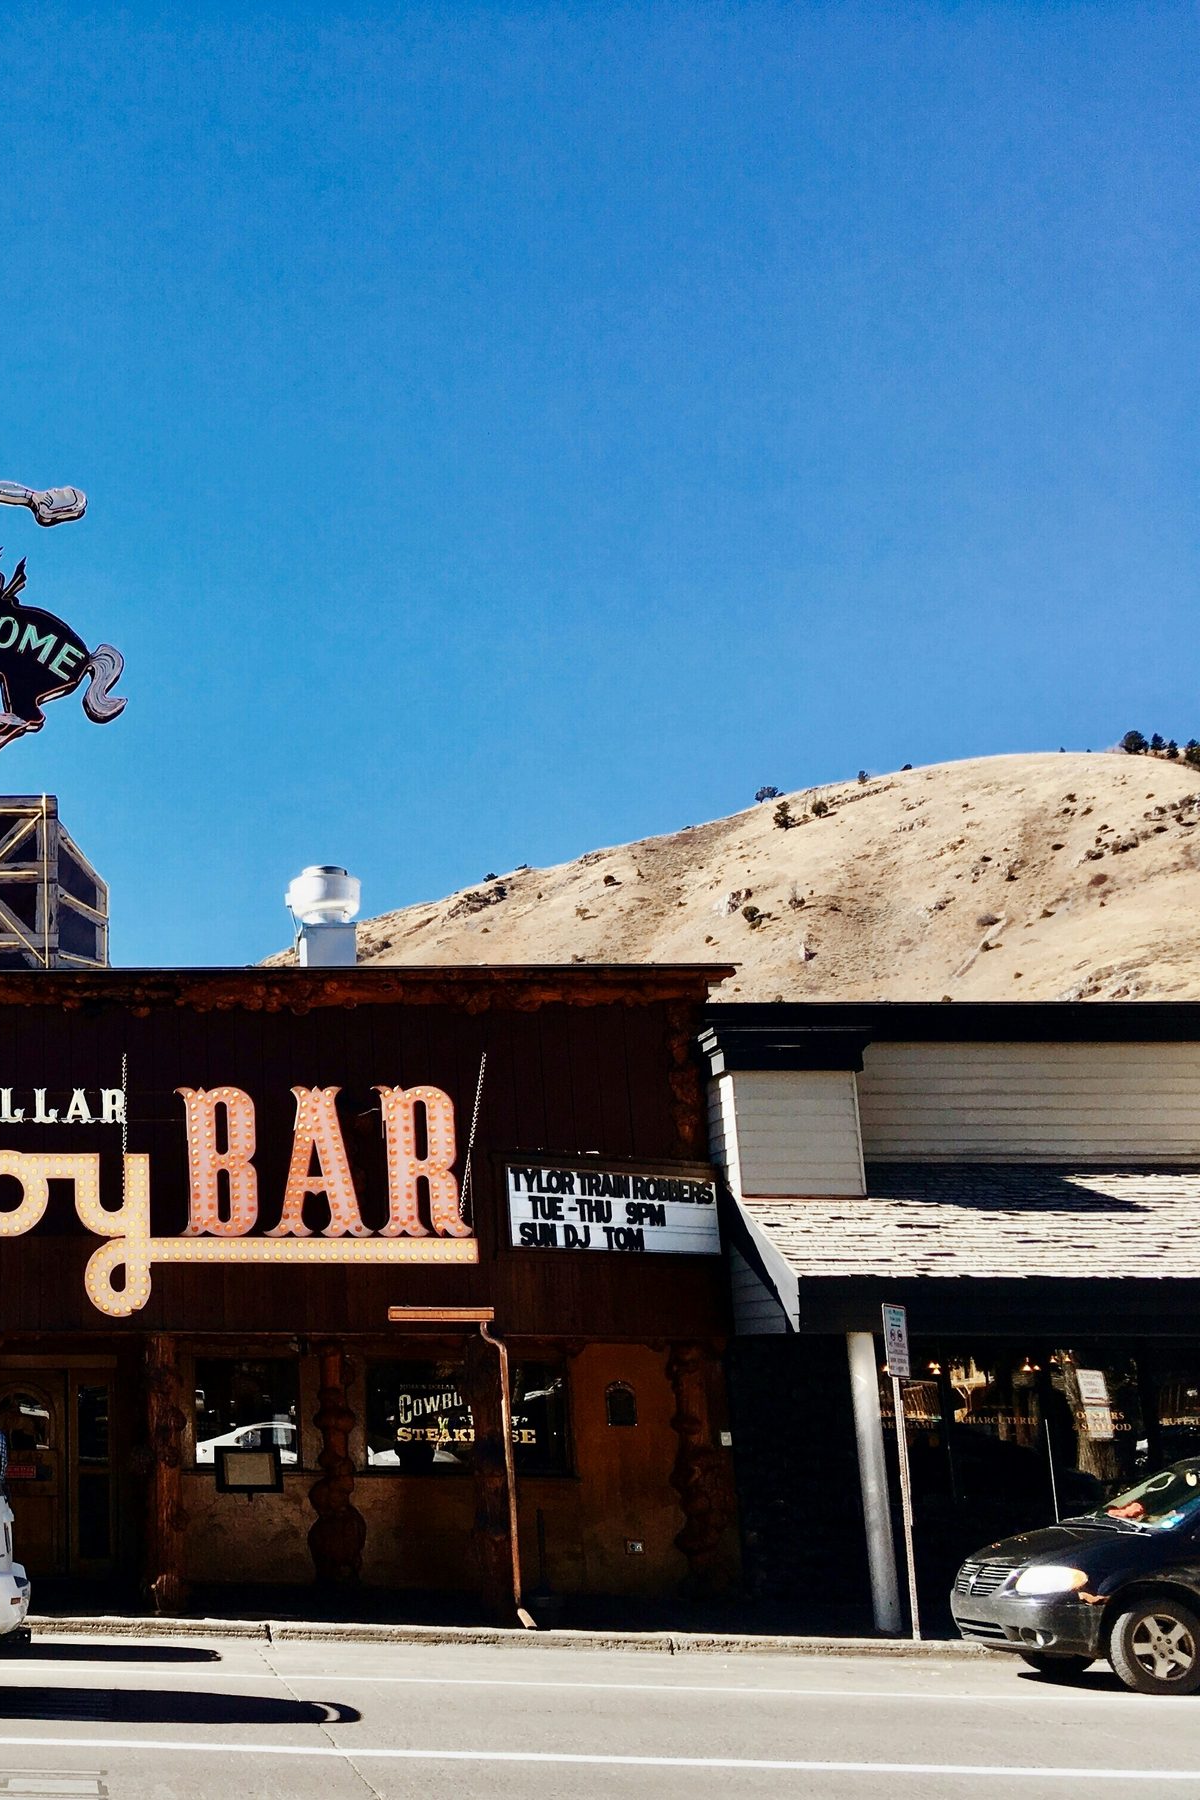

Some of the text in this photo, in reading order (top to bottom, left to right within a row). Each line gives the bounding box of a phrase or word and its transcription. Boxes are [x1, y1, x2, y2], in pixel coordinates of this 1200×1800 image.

[172, 1085, 473, 1237] BAR
[510, 1167, 714, 1204] TYLOR TRAIN ROBBERS
[625, 1201, 666, 1227] 9PM
[519, 1222, 645, 1251] SUN DJ TOM
[399, 1391, 472, 1424] COWBO
